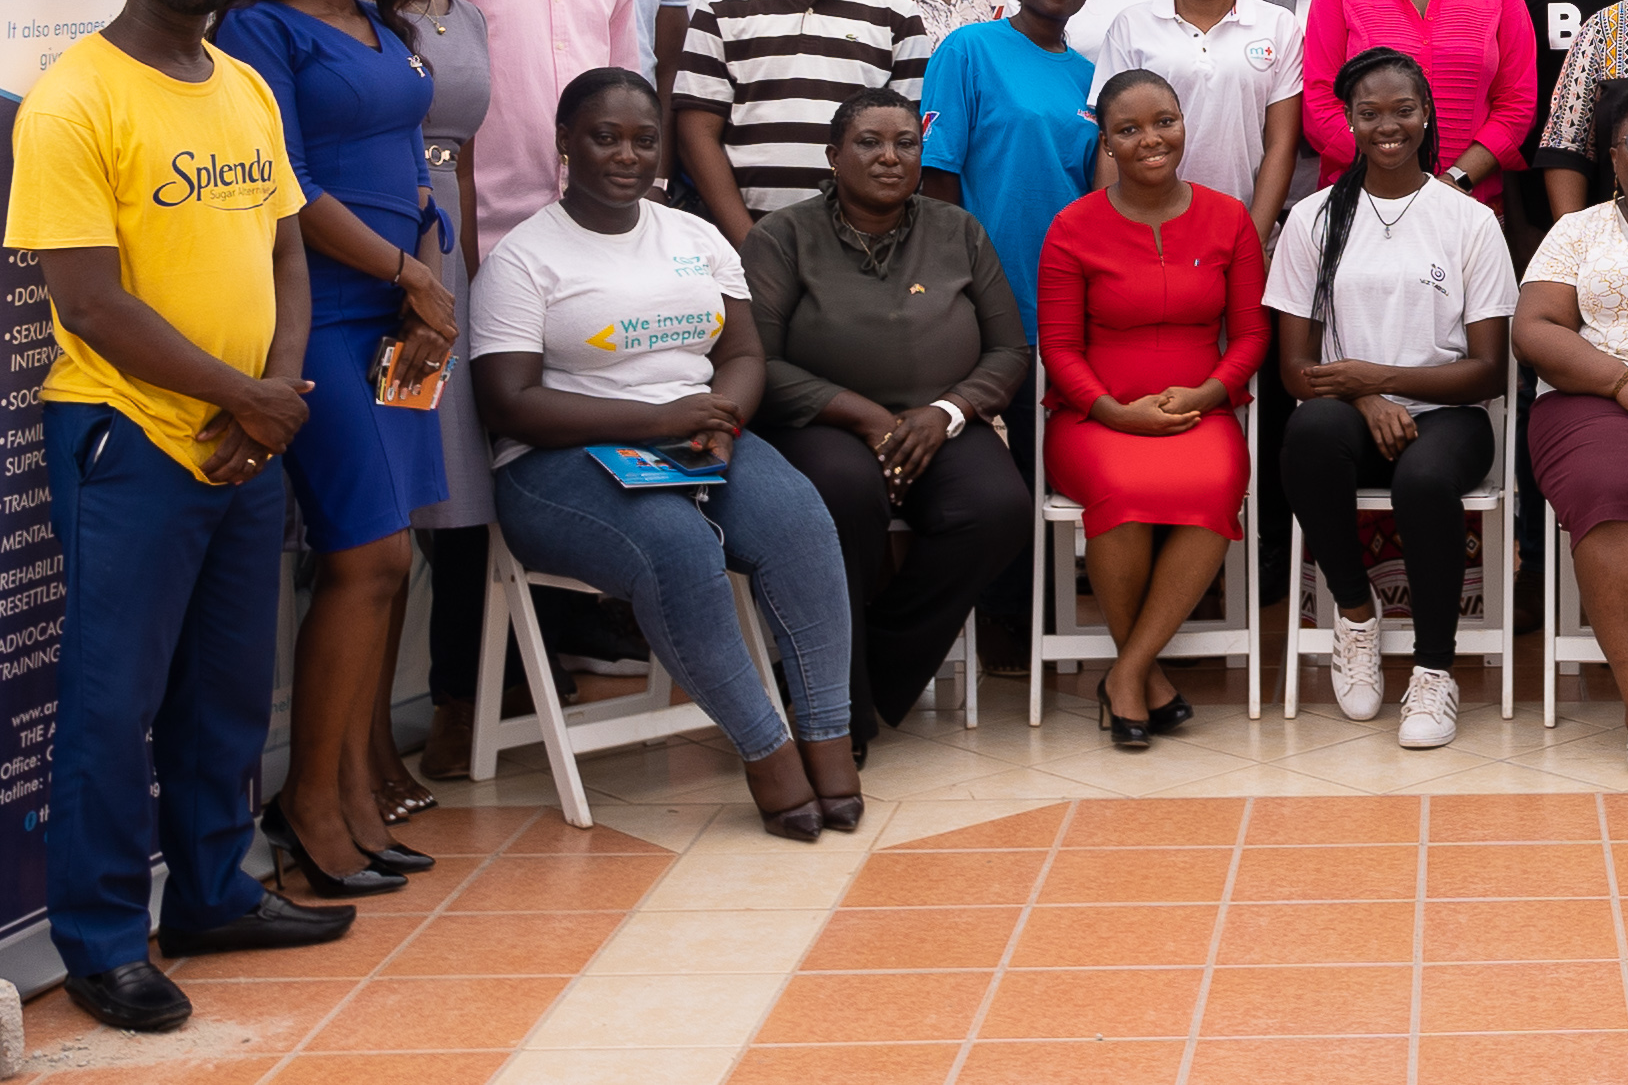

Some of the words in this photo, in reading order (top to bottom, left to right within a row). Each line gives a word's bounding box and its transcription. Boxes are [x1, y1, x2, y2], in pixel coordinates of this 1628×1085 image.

[7, 20, 18, 40] It
[22, 19, 50, 39] also
[153, 149, 273, 207] Splenda
[209, 189, 236, 202] Sugar
[620, 317, 650, 333] We
[657, 311, 712, 329] invest
[624, 335, 641, 350] in
[649, 326, 706, 349] people
[3, 486, 52, 515] TRAUM
[0, 521, 55, 554] MENTAL
[20, 724, 45, 749] THE
[0, 754, 42, 781] Office:
